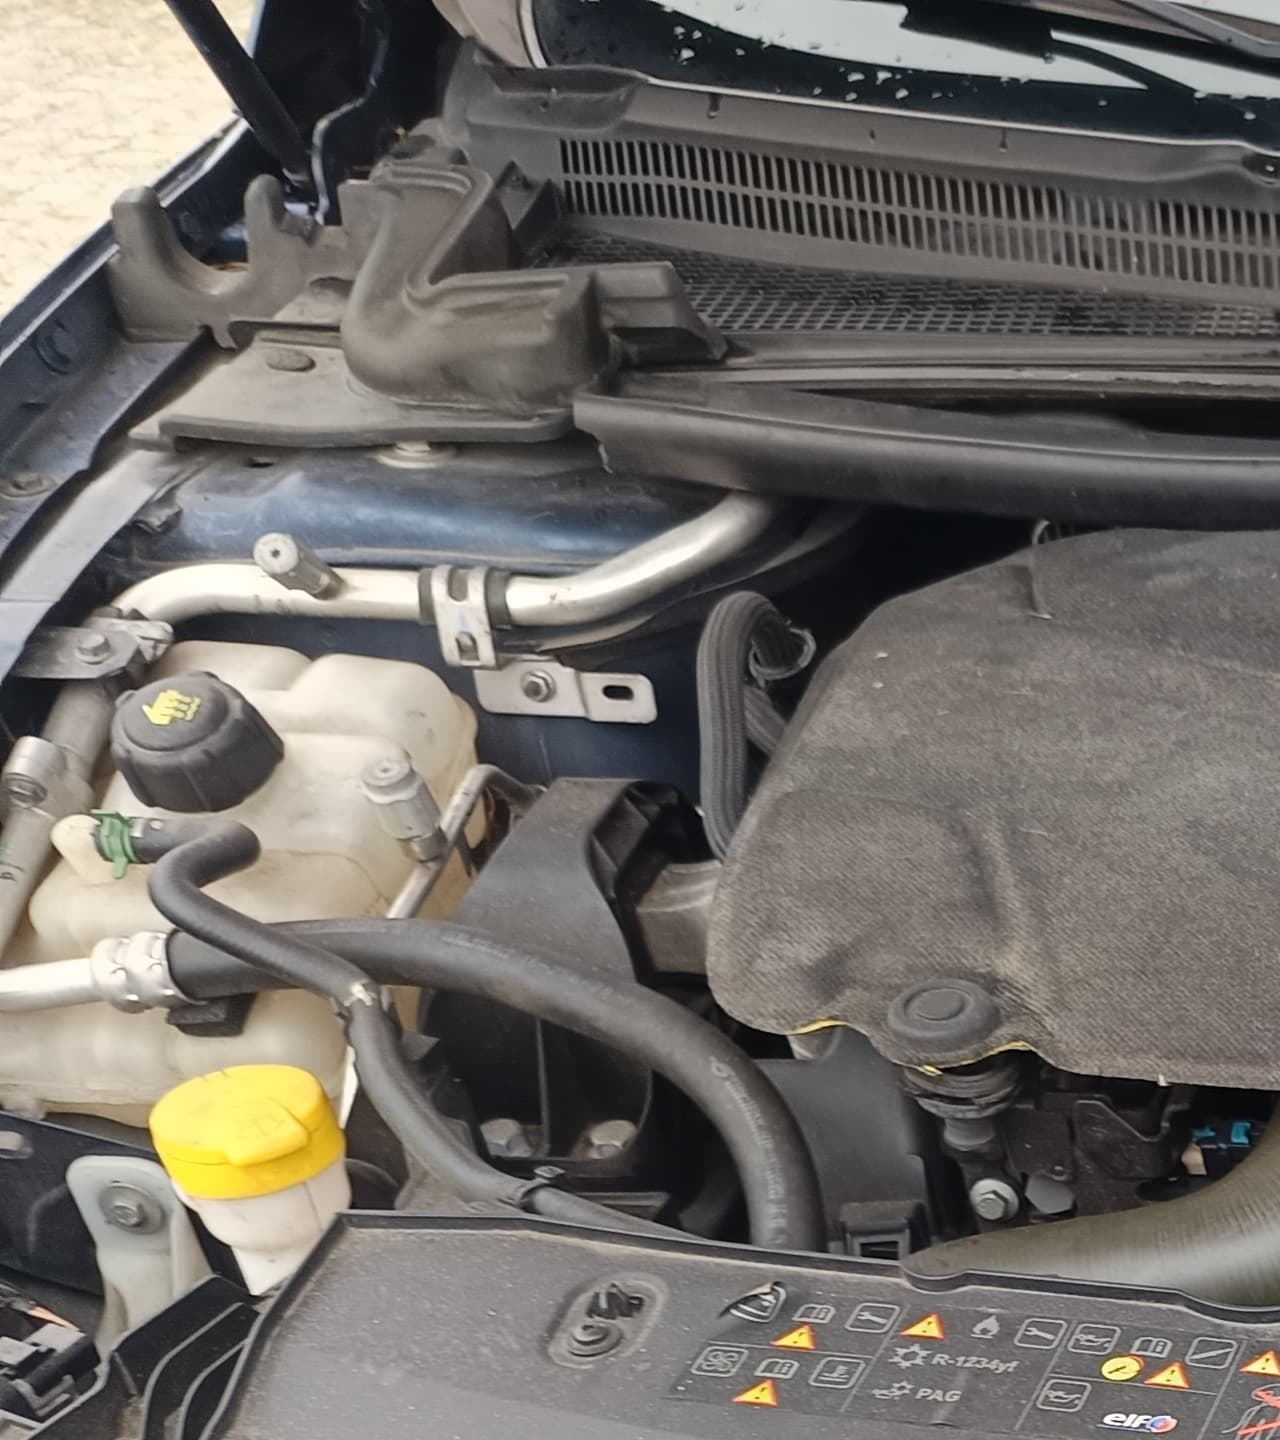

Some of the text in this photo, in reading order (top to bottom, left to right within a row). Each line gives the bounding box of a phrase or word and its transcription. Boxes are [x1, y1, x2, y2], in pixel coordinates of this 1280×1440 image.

[931, 1353, 1020, 1373] R-1234yf
[915, 1388, 962, 1402] PAG
[1102, 1412, 1153, 1428] elf
